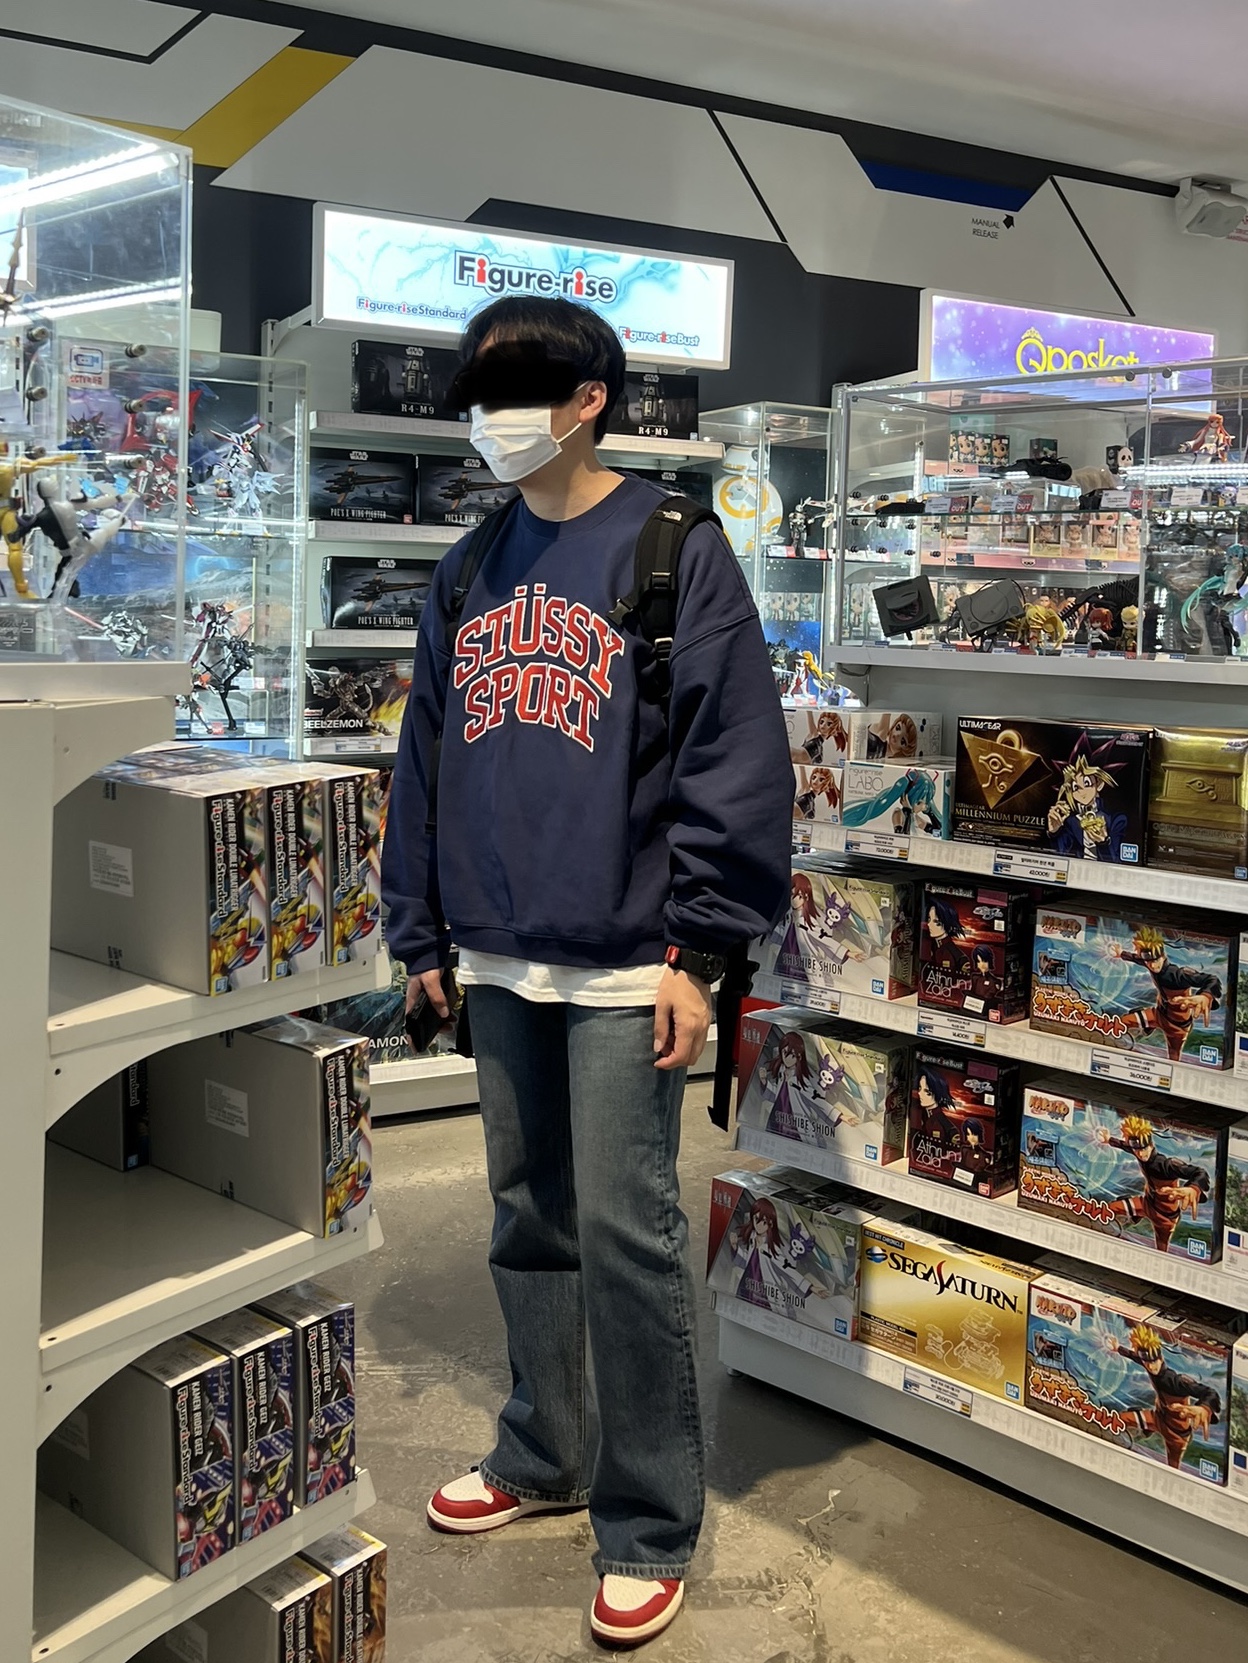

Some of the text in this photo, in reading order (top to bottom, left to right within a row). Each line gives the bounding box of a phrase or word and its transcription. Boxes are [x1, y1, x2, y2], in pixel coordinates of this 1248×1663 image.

[971, 217, 1000, 230] MANUAL
[972, 228, 999, 240] RELEASE
[457, 254, 615, 300] Figure-rise
[453, 583, 626, 700] STÜSSY
[464, 662, 601, 753] SPORT
[346, 781, 354, 804] KAMEN
[848, 774, 884, 792] LABO
[225, 798, 236, 822] KAMEN
[285, 789, 295, 812] KAMEN
[287, 813, 296, 832] RIDER
[955, 807, 1011, 821] MILLENNIUM
[1013, 814, 1046, 826] PUZZLE
[227, 823, 236, 842] RIDER
[781, 952, 844, 976] SHISHIBE SHION
[774, 1110, 836, 1139] SHISHIBE SHION
[744, 1277, 806, 1310] SHISHIBE SHION
[887, 1252, 939, 1285] SEGA
[936, 1260, 1019, 1314] SATURN
[319, 1322, 332, 1392] KAMEN RIDER GEIZ
[256, 1351, 269, 1424] KAMEN RIDER GEIZ
[191, 1380, 204, 1456] KAMEN RIDER GEIZ
[356, 1568, 364, 1593] KAMEN
